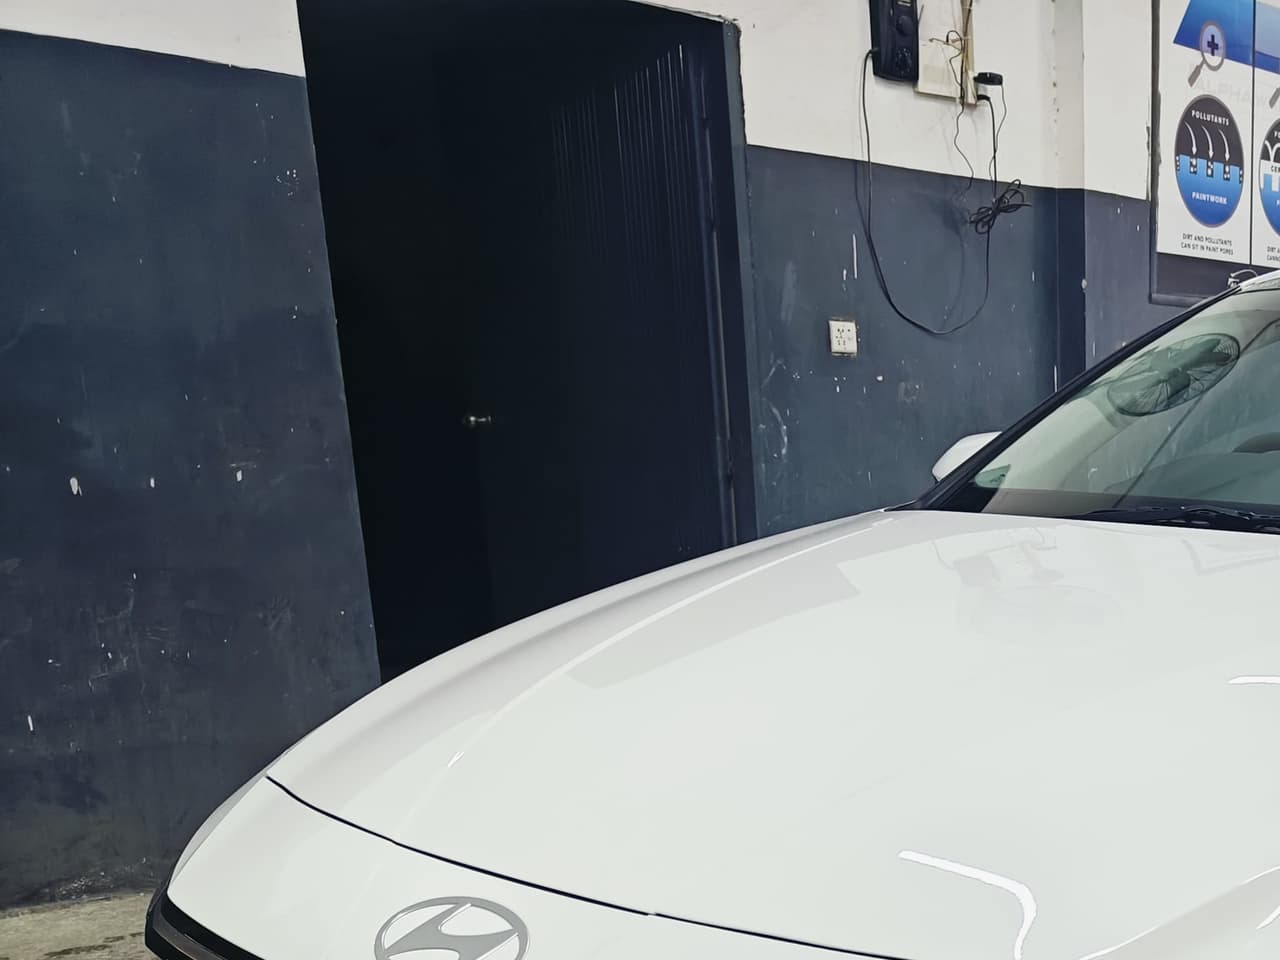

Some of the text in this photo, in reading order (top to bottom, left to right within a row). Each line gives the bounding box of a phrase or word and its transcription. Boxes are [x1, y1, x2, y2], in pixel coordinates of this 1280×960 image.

[1191, 109, 1230, 127] POLLUTANTS
[1191, 191, 1228, 205] PAINTWORK
[1182, 233, 1193, 241] DIRT
[1205, 236, 1233, 246] POLLUTANTS
[1206, 245, 1219, 253] PAINT
